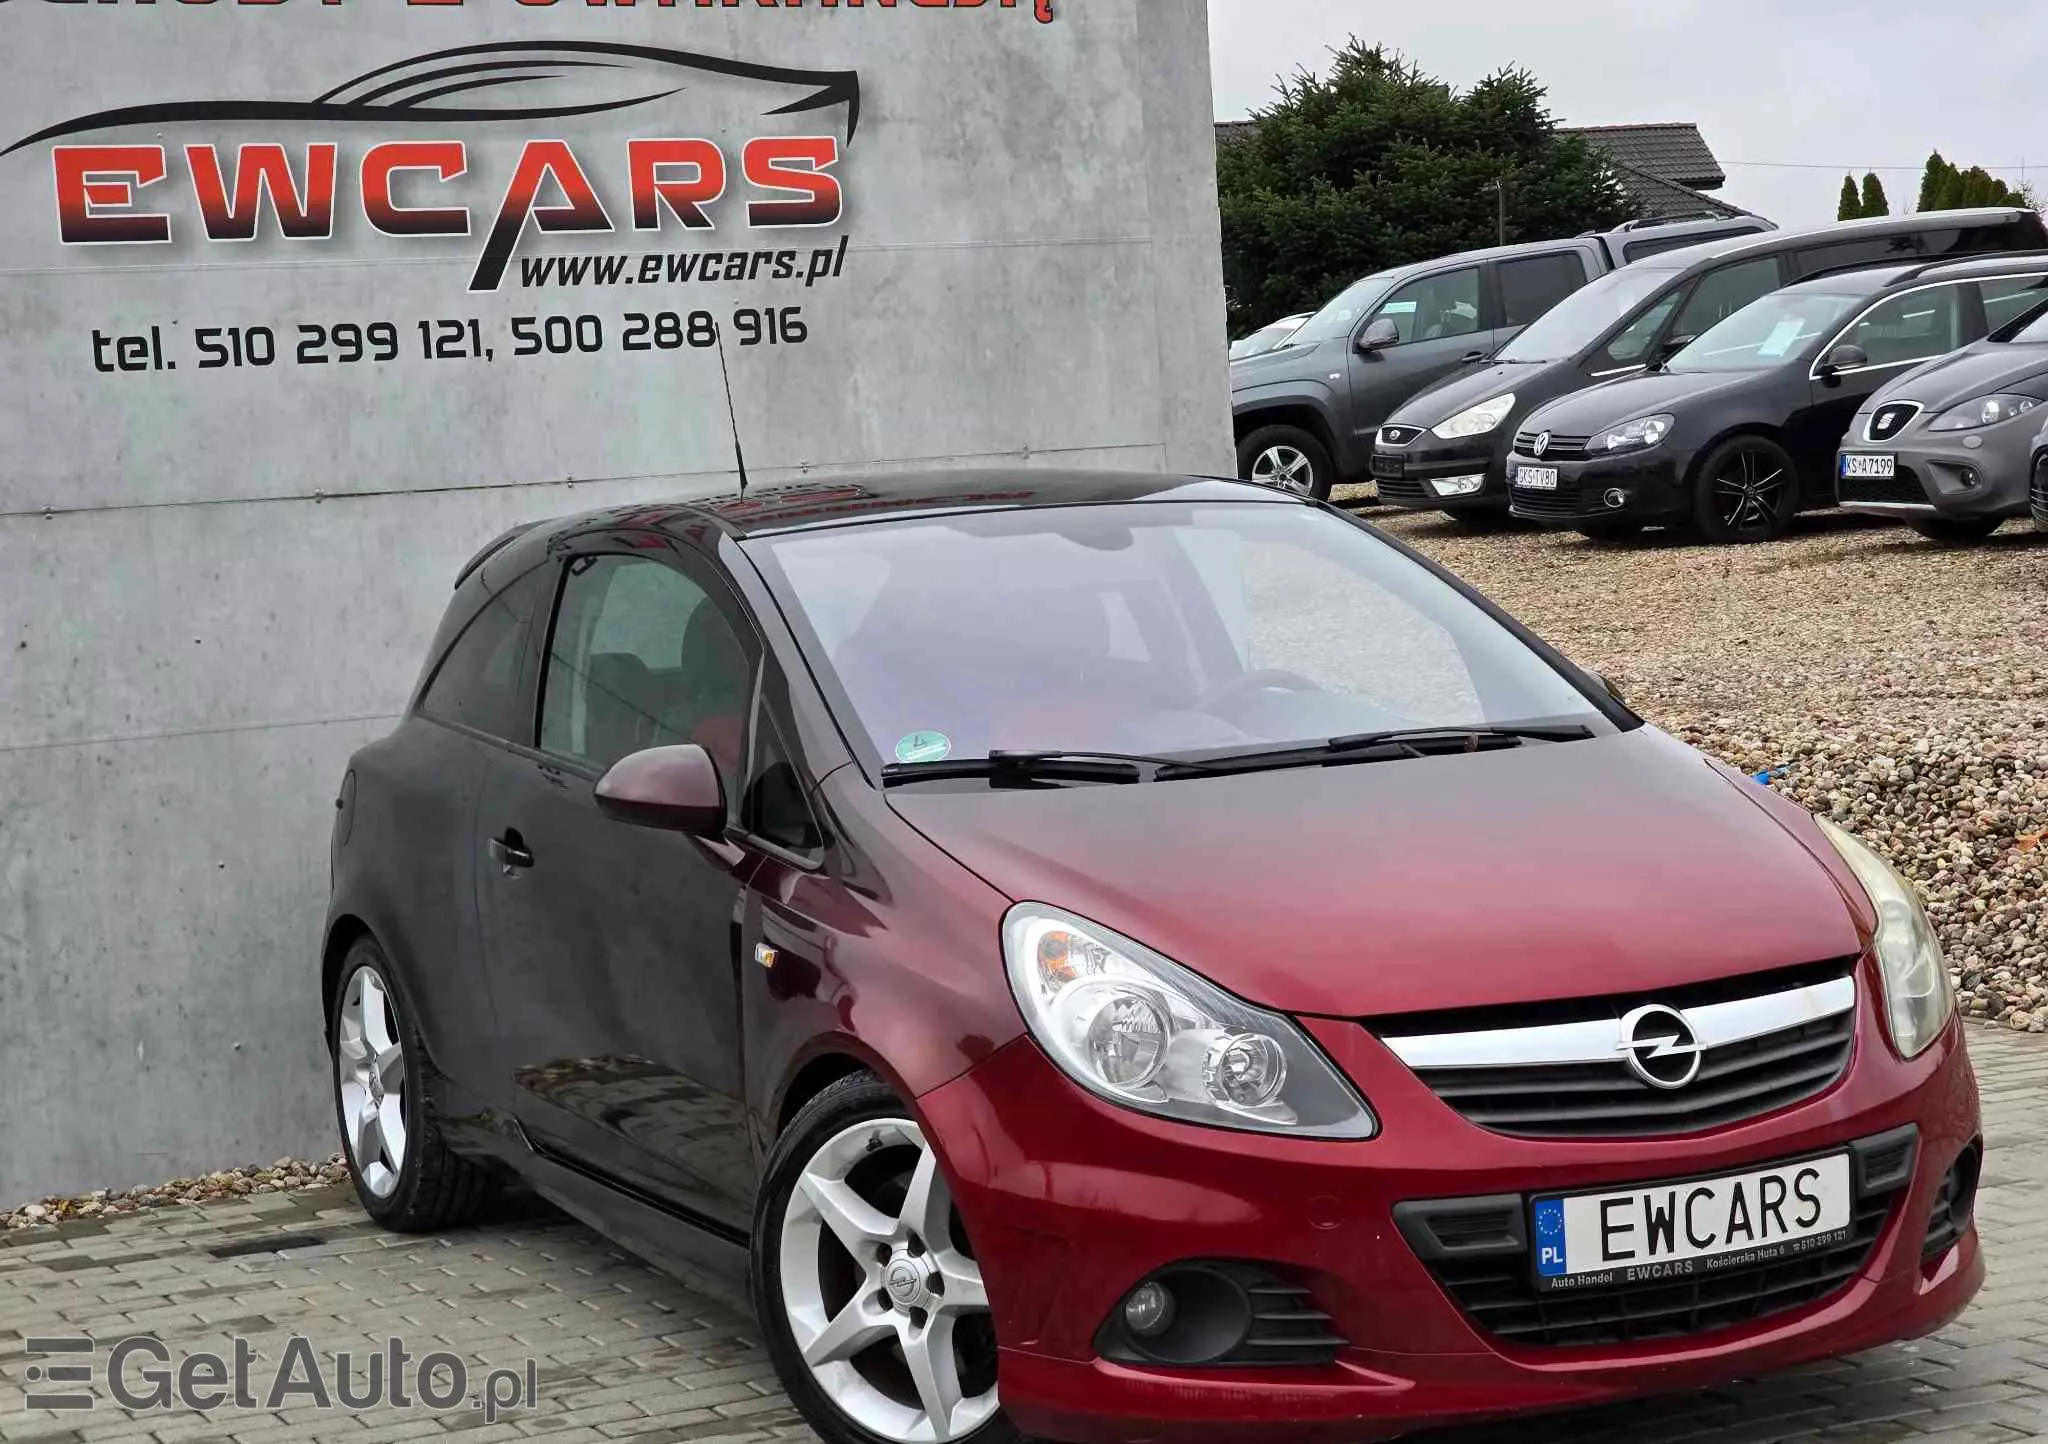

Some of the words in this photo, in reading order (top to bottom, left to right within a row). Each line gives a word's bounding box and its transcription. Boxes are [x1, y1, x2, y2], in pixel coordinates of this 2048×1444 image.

[53, 136, 842, 292] EWCARS
[520, 235, 848, 287] www.ewcars.pl
[92, 325, 176, 373] tel.
[196, 326, 275, 368] 510
[296, 321, 398, 364] 299
[418, 318, 494, 362] 121,
[513, 314, 603, 356] 500
[622, 311, 716, 351] 288
[733, 306, 808, 346] 916
[1600, 1168, 1822, 1262] EWCARS
[1541, 1247, 1564, 1265] PL
[1551, 1277, 1575, 1289] Auto
[1577, 1272, 1613, 1286] Handel
[1626, 1260, 1694, 1281] EWCARS
